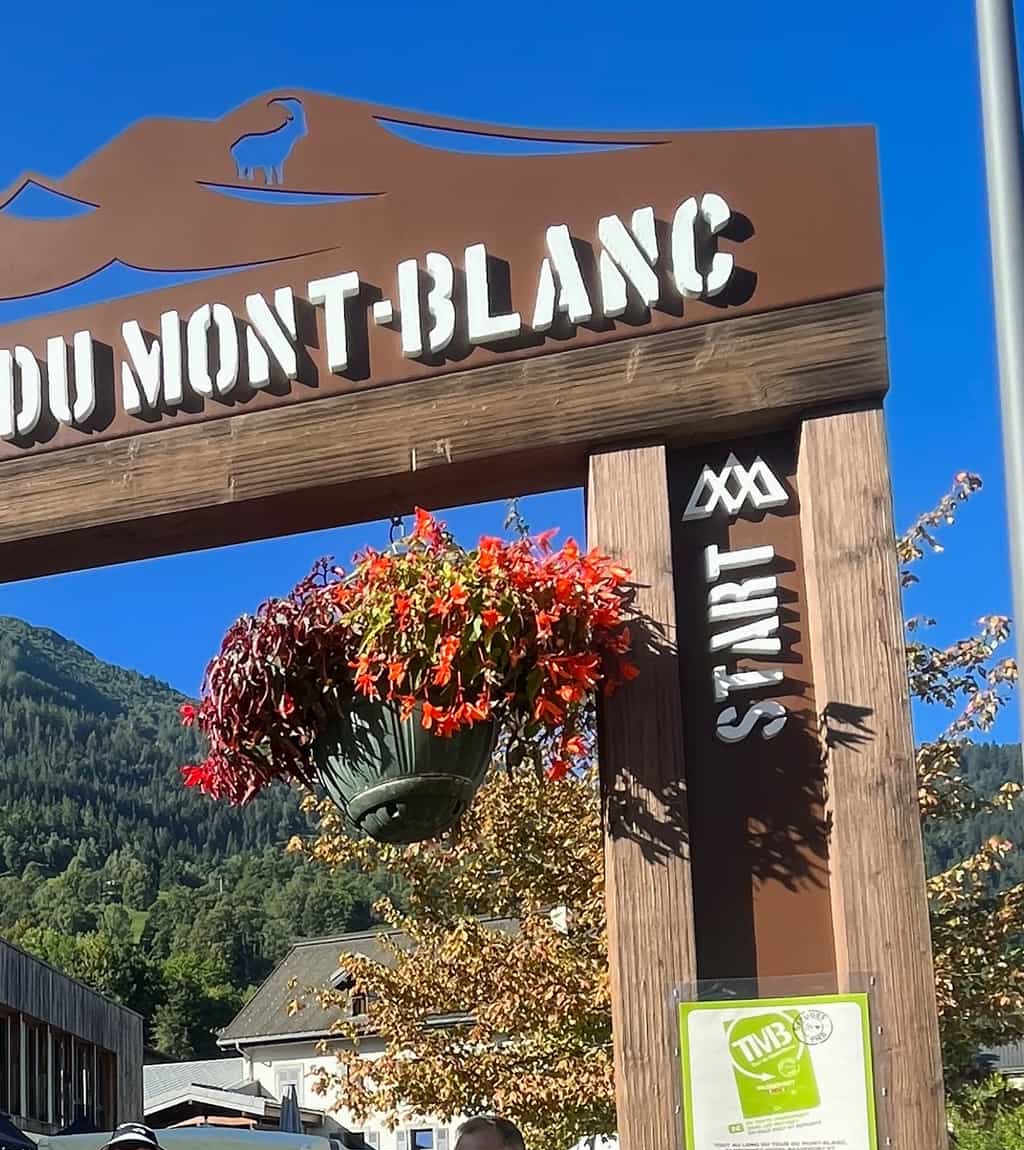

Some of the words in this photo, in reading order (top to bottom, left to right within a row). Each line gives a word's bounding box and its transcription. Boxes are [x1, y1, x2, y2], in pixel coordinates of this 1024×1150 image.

[120, 192, 735, 417] MONT-BLANC
[704, 543, 788, 743] START
[731, 1021, 793, 1063] TMB
